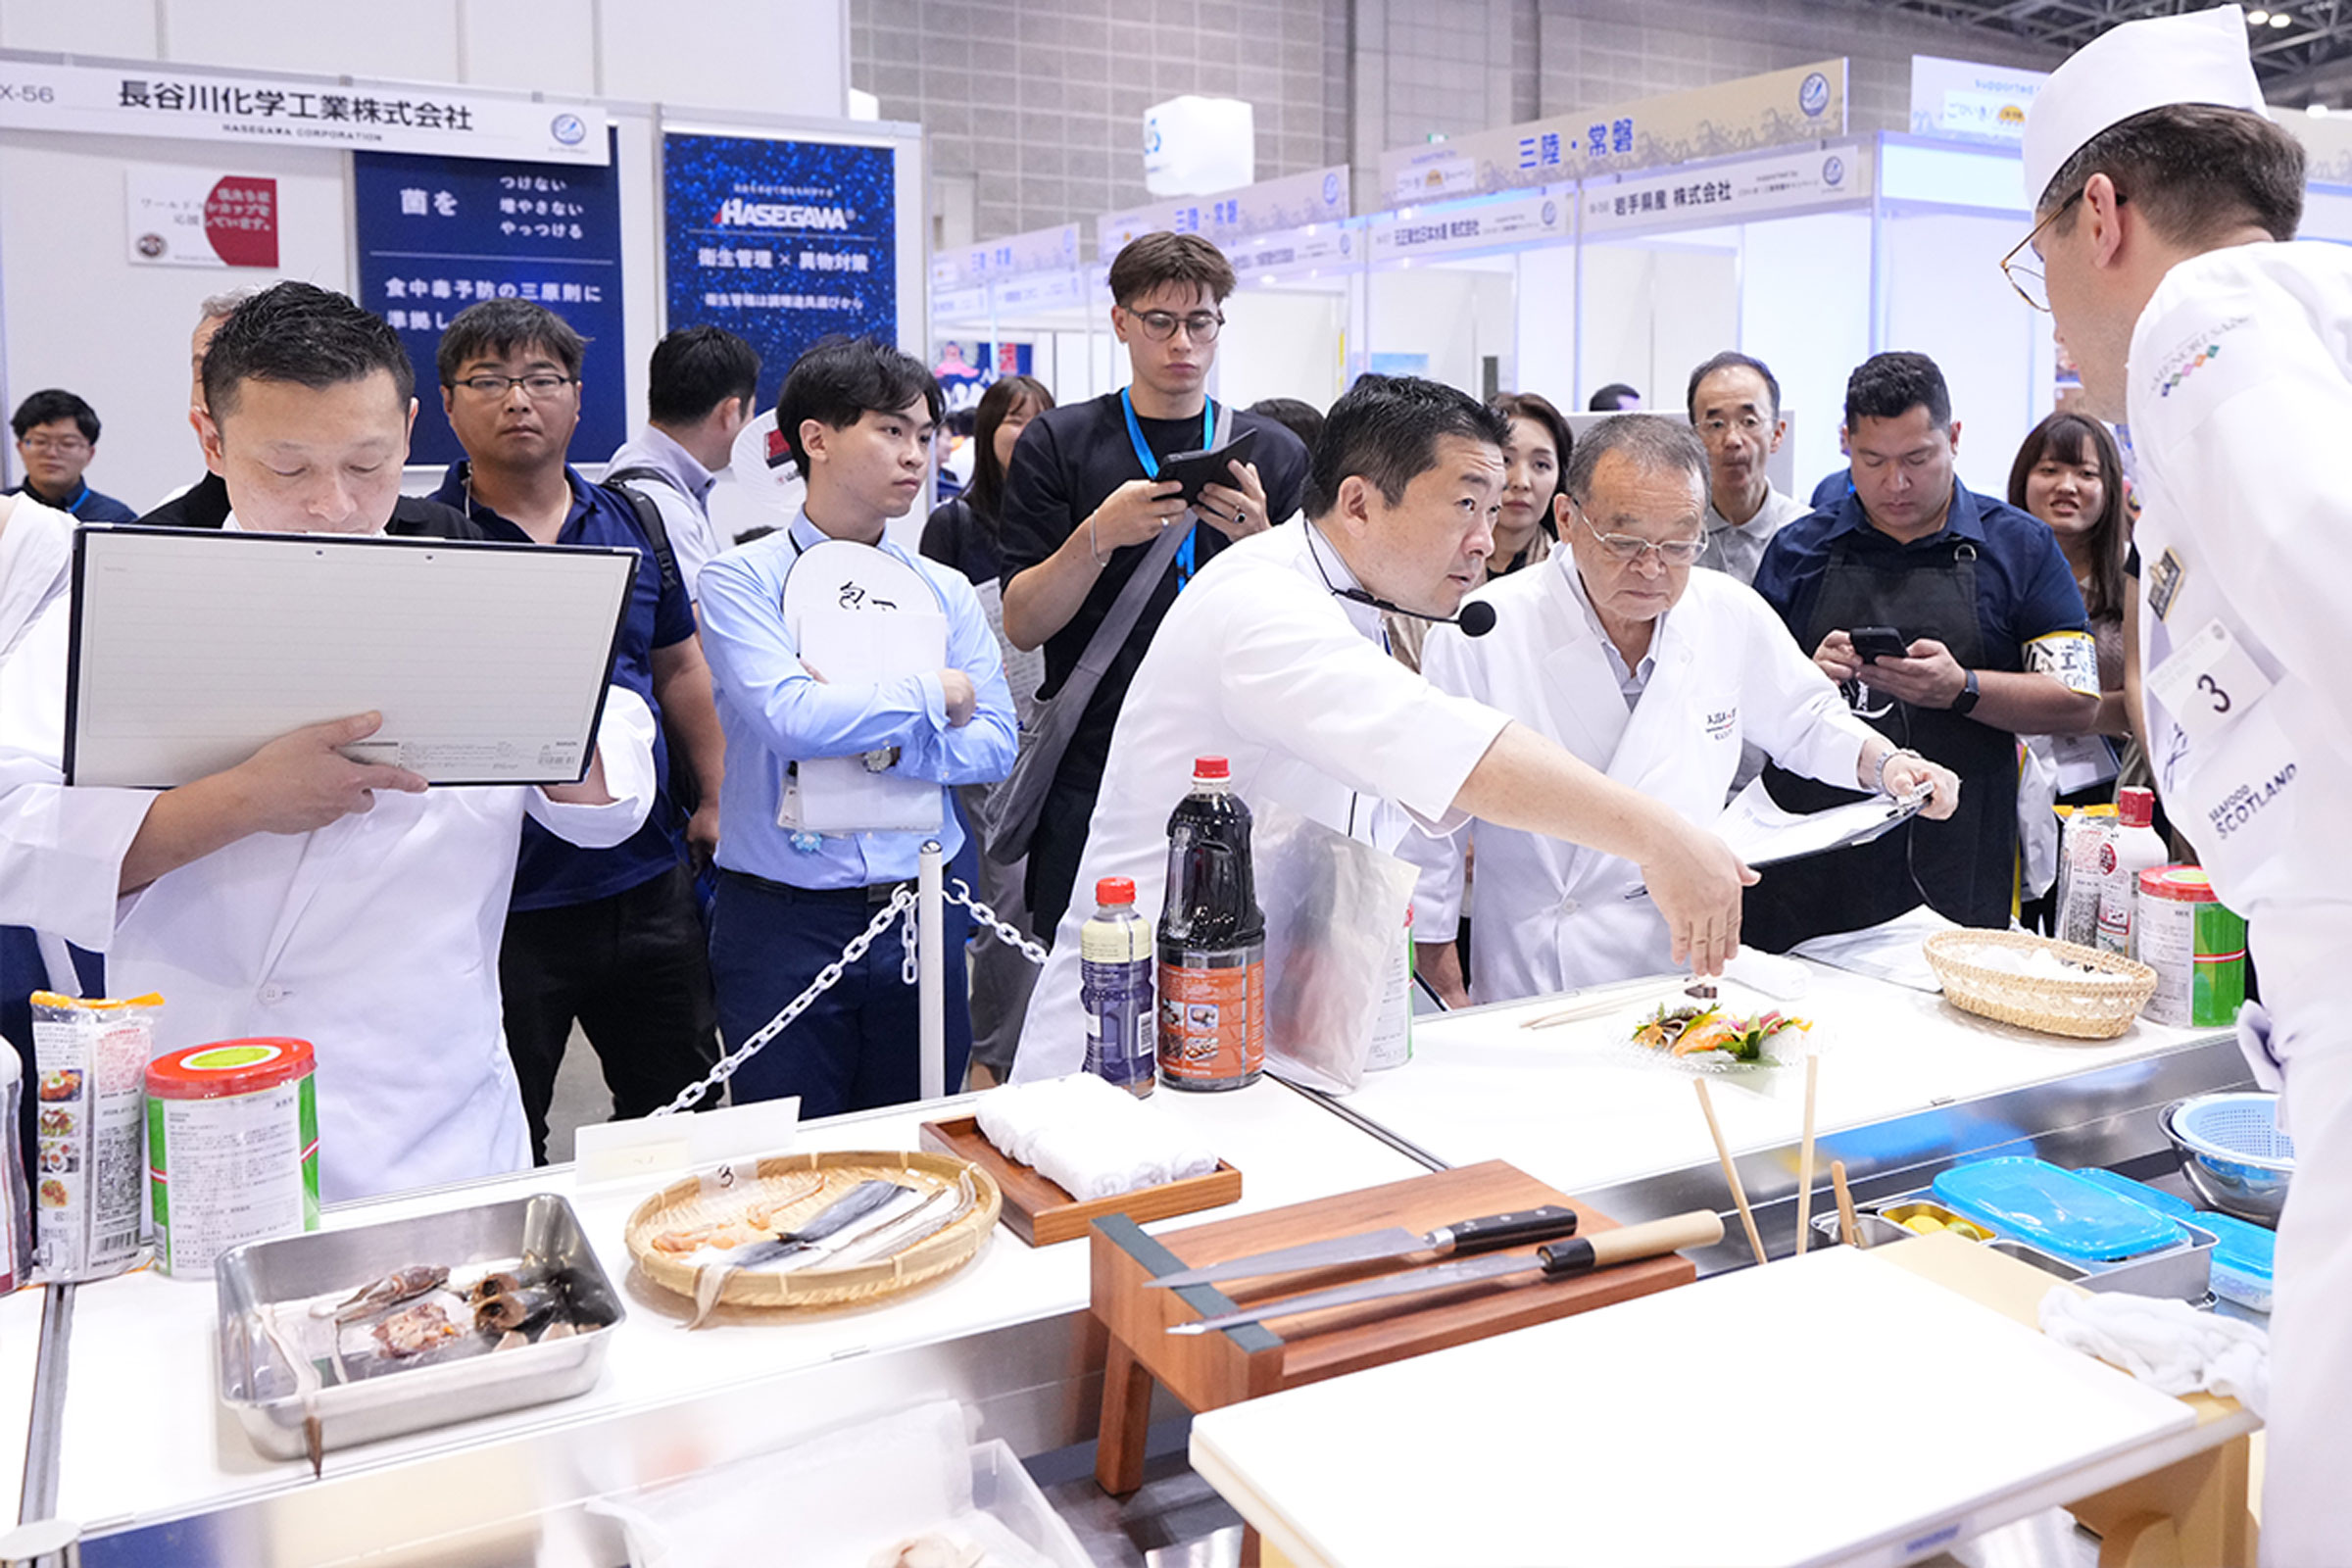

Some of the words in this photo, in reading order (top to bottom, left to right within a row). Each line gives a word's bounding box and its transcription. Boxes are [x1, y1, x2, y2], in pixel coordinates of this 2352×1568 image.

[120, 80, 472, 131] 長谷川化学工業株式会社
[222, 123, 292, 136] HASEGAWA
[296, 127, 382, 141] CORPORATION
[1519, 118, 1634, 169] 三陸・常磐
[500, 176, 566, 192] つけない
[1614, 189, 1667, 216] 岩手県産
[1673, 179, 1732, 207] 株式会社
[400, 188, 458, 217] 菌を
[500, 198, 583, 218] 増やさない
[719, 198, 848, 231] HASEGAWA
[500, 220, 583, 239] やっつける
[698, 248, 773, 270] 衛生管理
[799, 251, 868, 272] 異物対策
[385, 277, 602, 303] 食中毒予防の三原則に
[2197, 674, 2230, 713] 3
[2216, 763, 2297, 840] SCOTLAND
